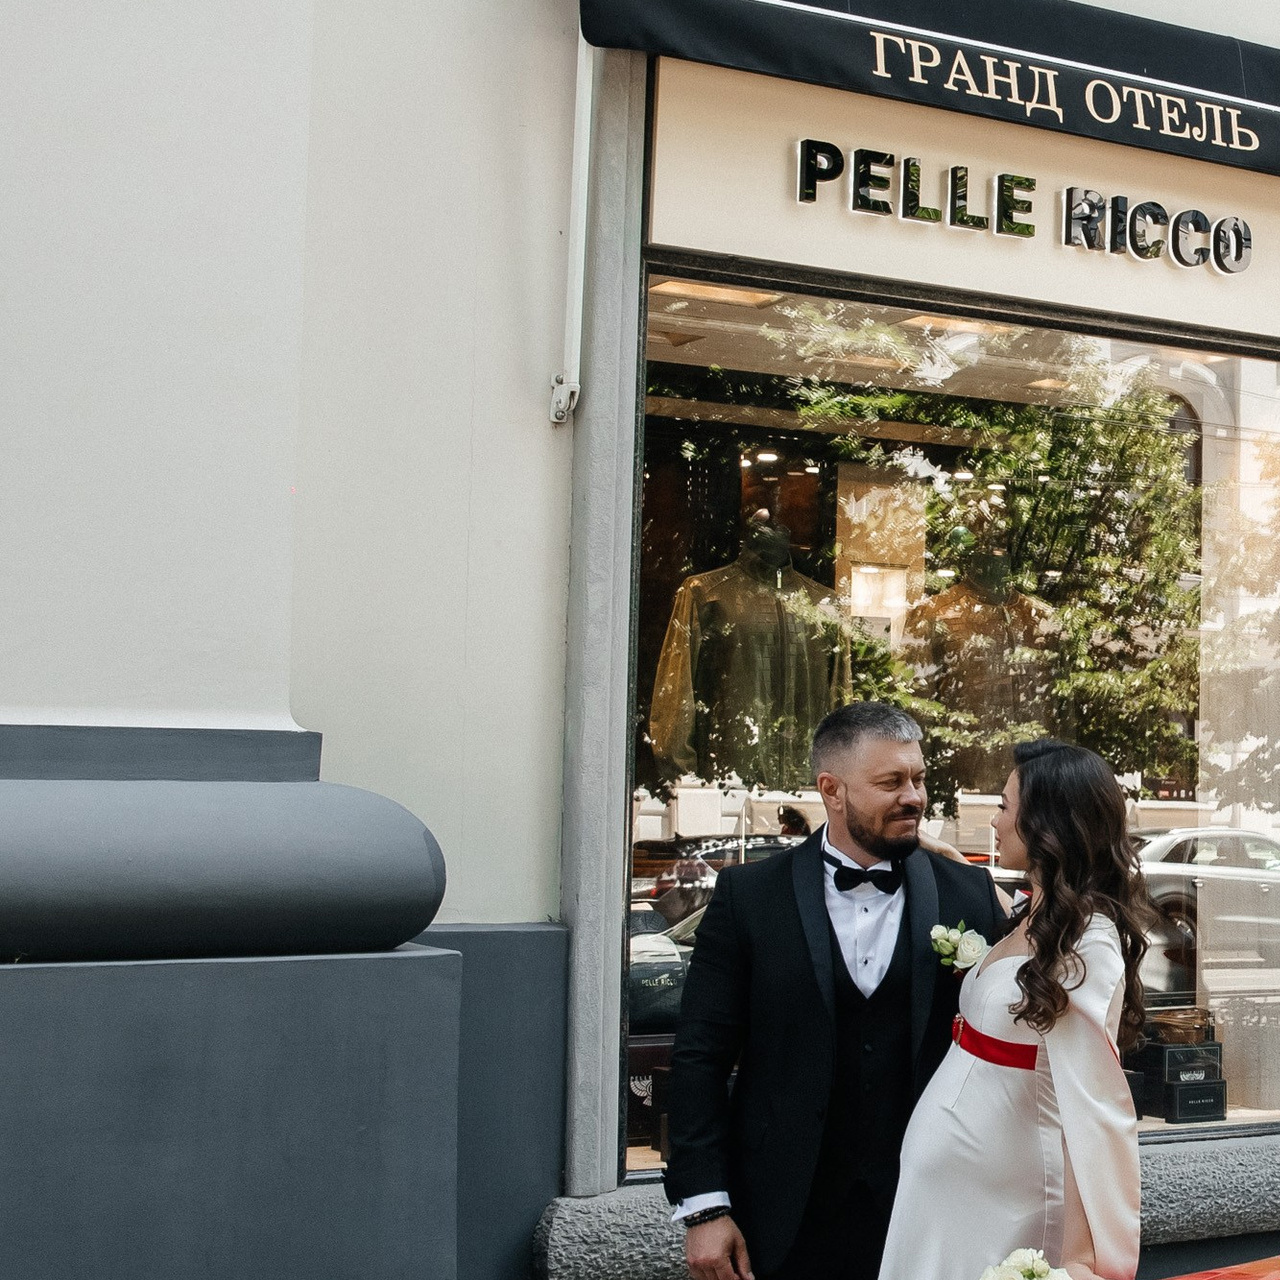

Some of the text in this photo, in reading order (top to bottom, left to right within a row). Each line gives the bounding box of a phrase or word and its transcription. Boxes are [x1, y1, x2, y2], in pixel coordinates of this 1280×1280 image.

[869, 31, 1260, 151] ГРАНД ОТЕЛЬ
[798, 138, 1252, 276] PELLE RICCO
